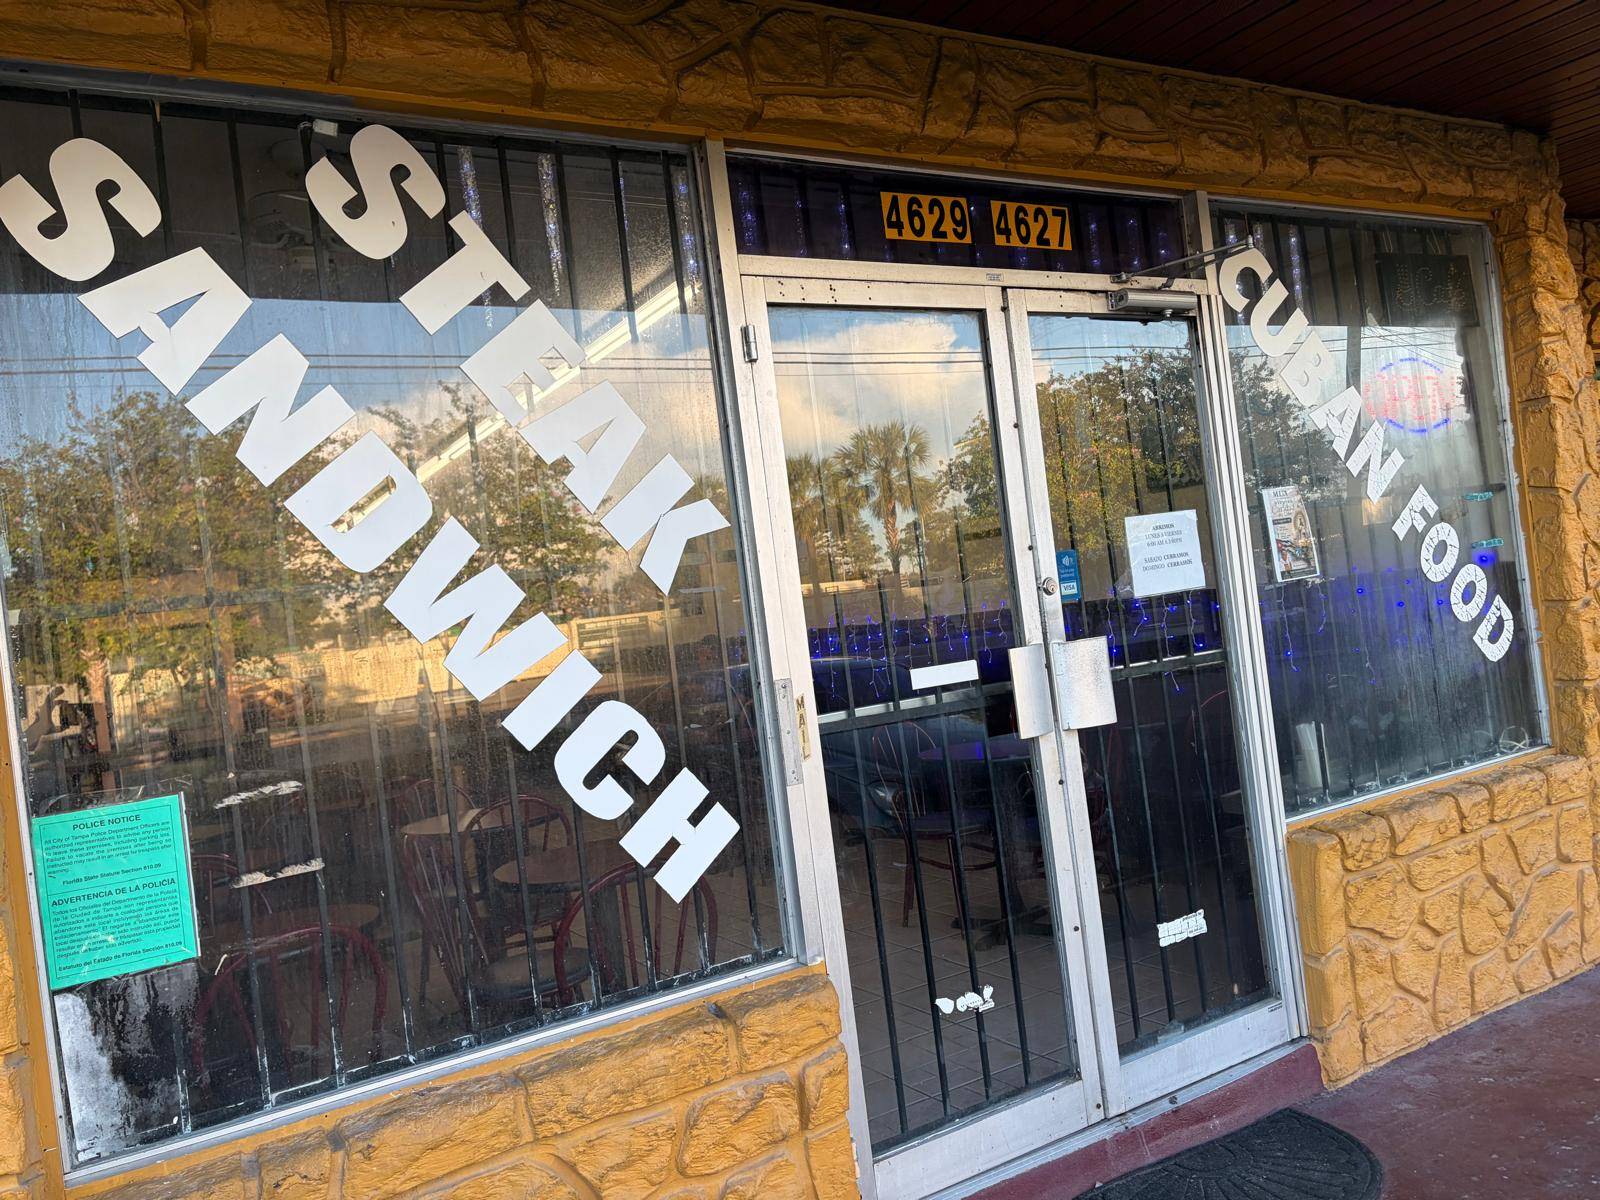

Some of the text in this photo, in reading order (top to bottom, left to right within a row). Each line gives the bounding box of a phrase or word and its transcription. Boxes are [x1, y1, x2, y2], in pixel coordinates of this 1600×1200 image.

[886, 194, 1068, 248] 4629 4627
[305, 124, 730, 595] STEAK
[1219, 248, 1514, 662] CUBAN FOOD
[0, 137, 740, 904] SANDWICH
[1063, 584, 1076, 592] VISA
[795, 692, 812, 761] MAIL
[73, 813, 141, 832] POLICE NOTICE
[51, 877, 176, 908] ADVERTENCIA DE LA POLICIA
